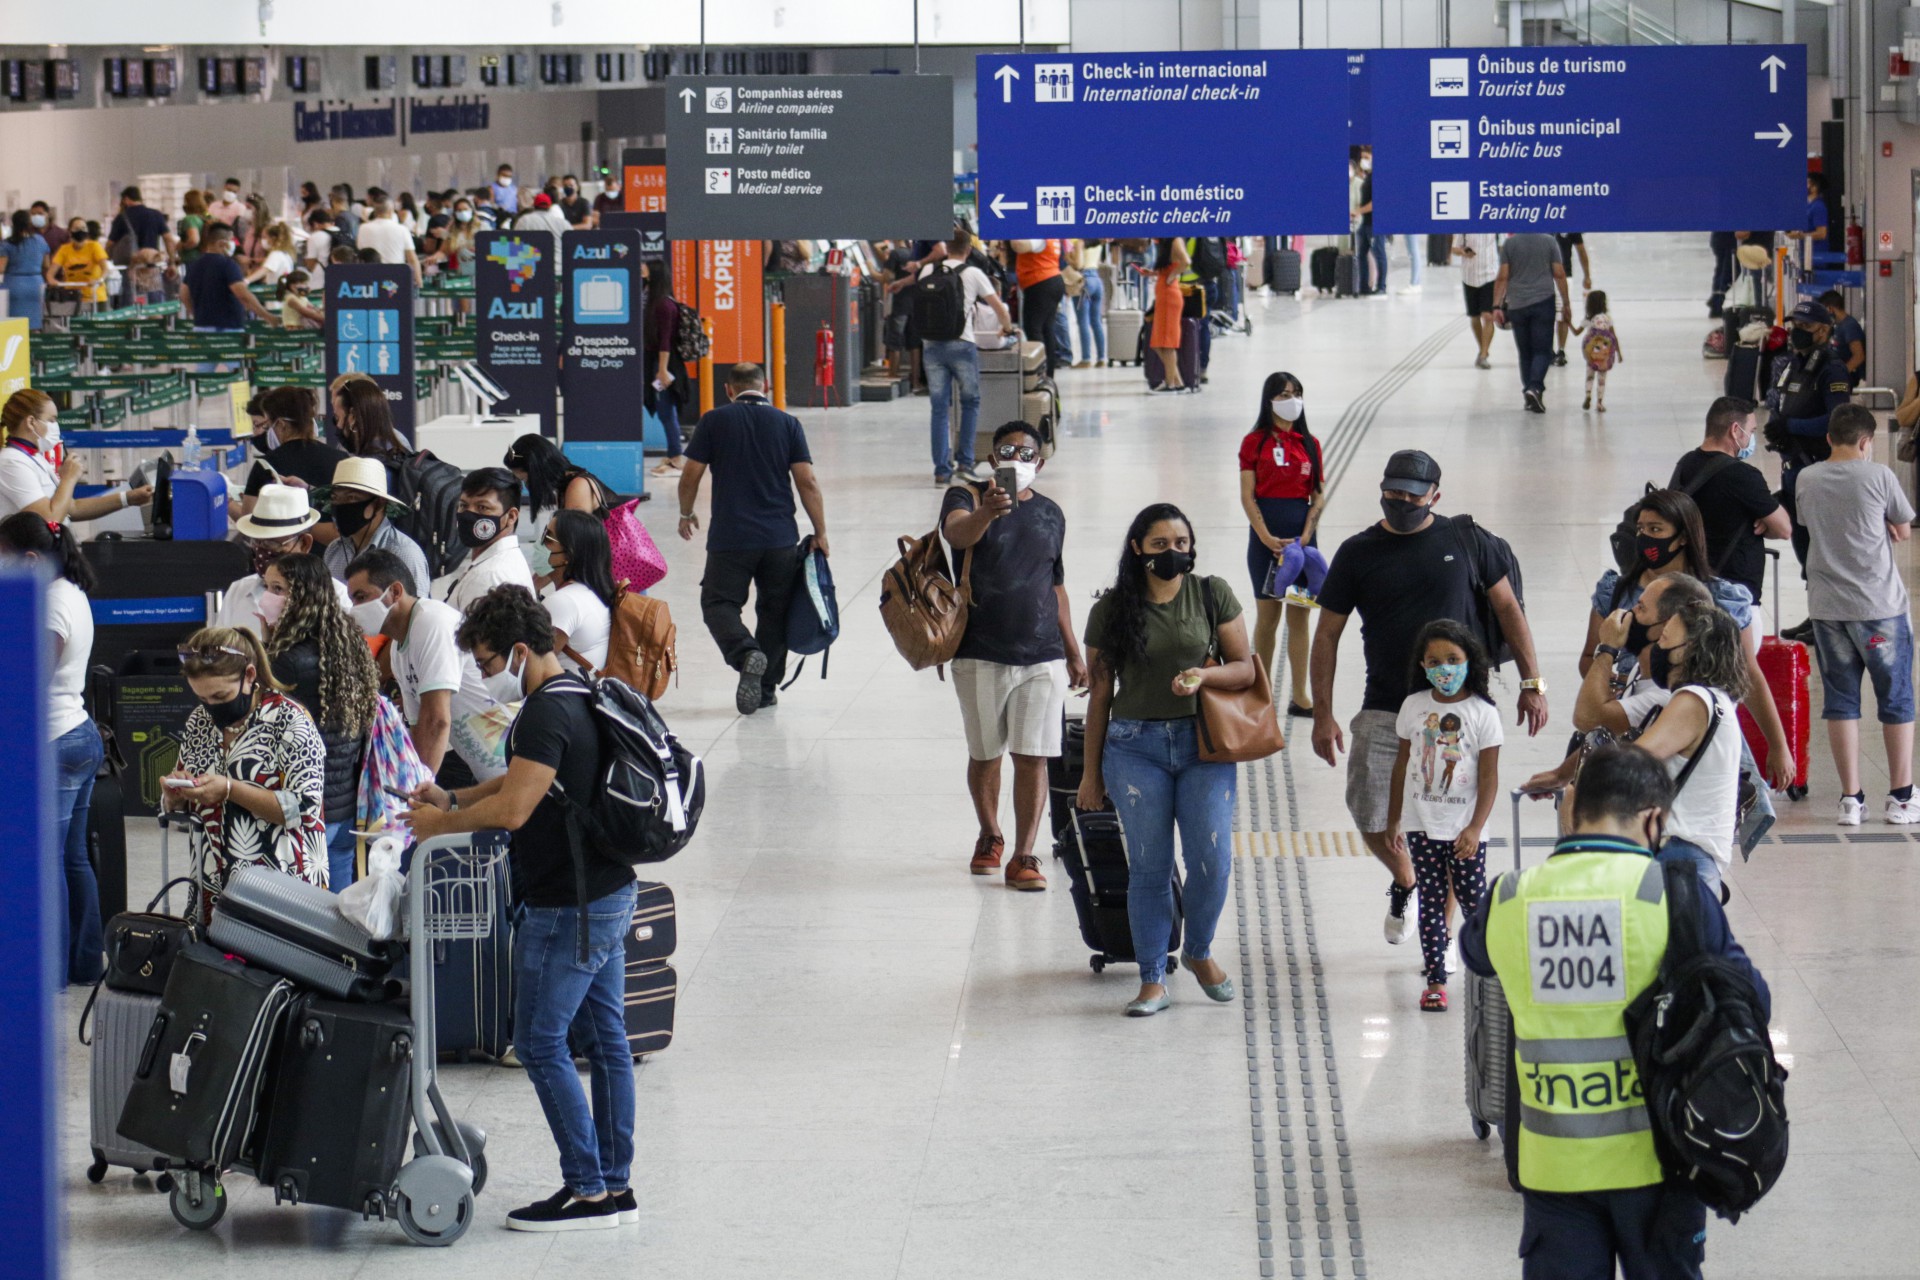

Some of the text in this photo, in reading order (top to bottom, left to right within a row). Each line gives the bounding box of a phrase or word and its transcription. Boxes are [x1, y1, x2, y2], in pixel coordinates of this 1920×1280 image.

[1082, 60, 1267, 80] Check-in internacional
[1478, 54, 1627, 74] Ônibus de turismo
[737, 86, 843, 101] Companhias aéreas
[1083, 84, 1260, 102] International check-in
[1478, 80, 1566, 97] Tourist bus
[737, 103, 834, 116] Airline companies
[737, 127, 827, 140] Sanitário família
[1478, 116, 1621, 138] Ônibus municipal
[737, 144, 804, 156] Family toilet
[1478, 142, 1562, 158] Public bus
[737, 167, 811, 180] Posto médico
[737, 183, 823, 195] Medical service
[1084, 183, 1244, 203] Check-in doméstico
[1479, 181, 1610, 197] Estacionamento
[1436, 191, 1448, 215] E
[1084, 207, 1231, 225] Domestic check-in
[1479, 203, 1566, 223] Parking lot
[573, 244, 611, 259] Azul
[338, 281, 379, 298] Azul
[487, 297, 544, 319] Azul
[491, 331, 540, 342] Check-in
[574, 336, 629, 348] Despacho
[567, 346, 637, 358] de bagagens
[580, 358, 624, 370] Bag Drop
[122, 686, 156, 694] Bagagem
[168, 685, 184, 693] mão
[1538, 914, 1611, 948] DNA
[1540, 955, 1616, 990] 2004
